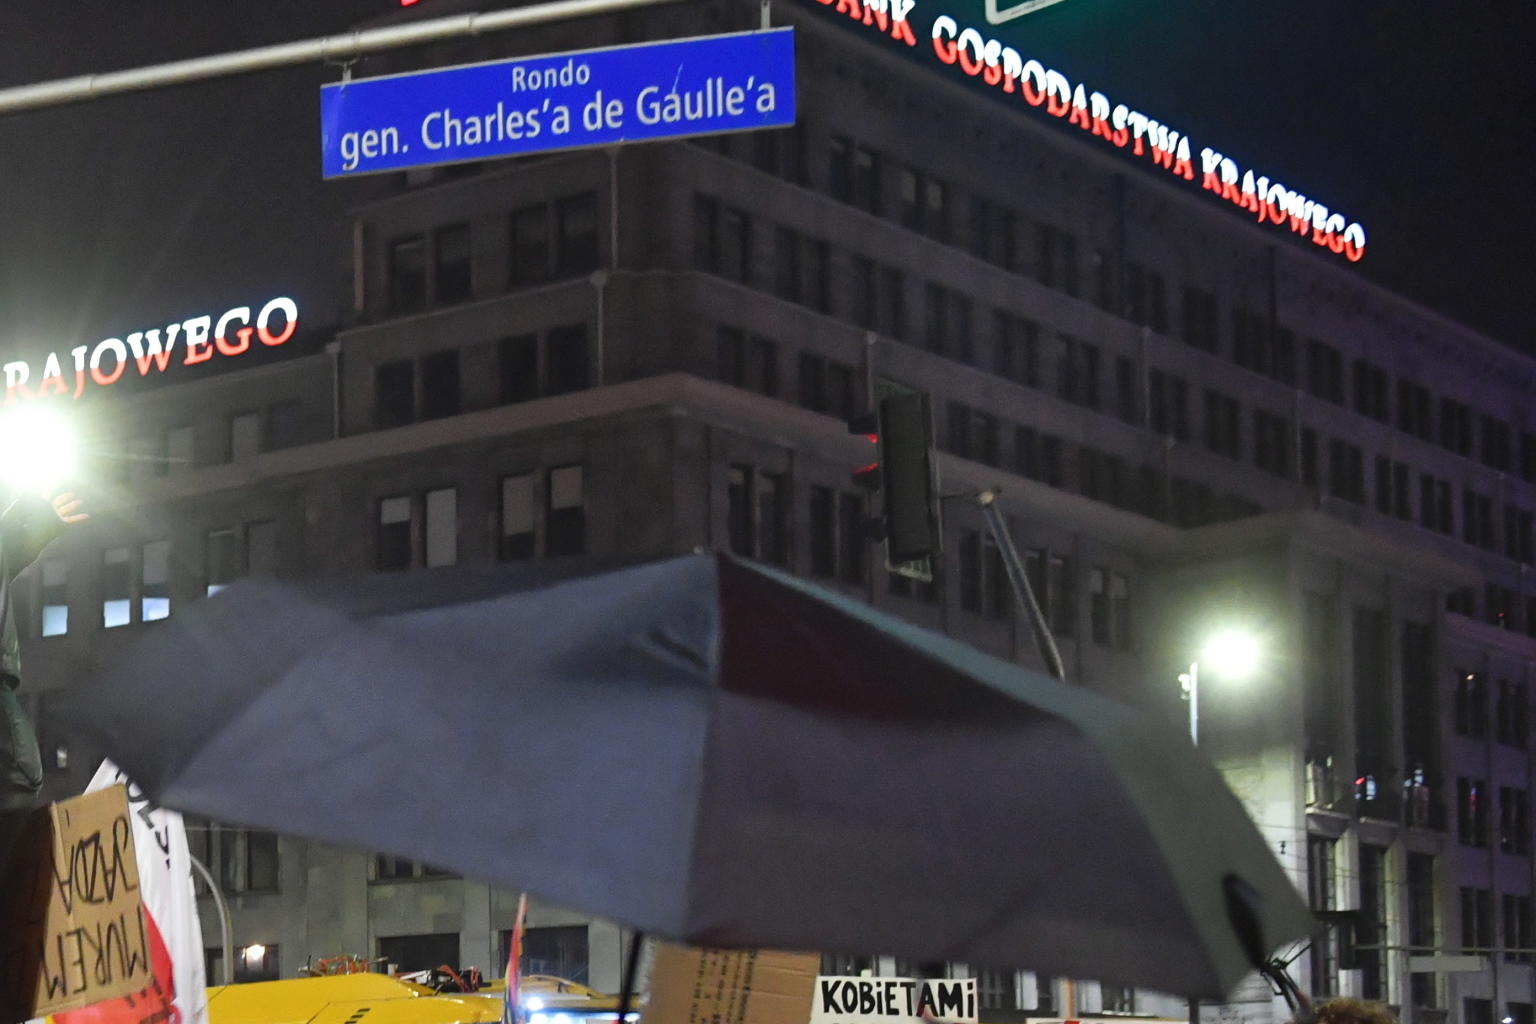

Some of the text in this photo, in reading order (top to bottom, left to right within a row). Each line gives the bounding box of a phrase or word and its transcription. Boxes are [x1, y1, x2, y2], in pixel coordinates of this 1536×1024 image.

[341, 76, 775, 171] gen. Charles'a de Gaulle'a
[512, 59, 590, 93] Rondo
[932, 15, 1195, 180] GOSPODARSTWA
[1201, 147, 1365, 262] KRAJOWEGO
